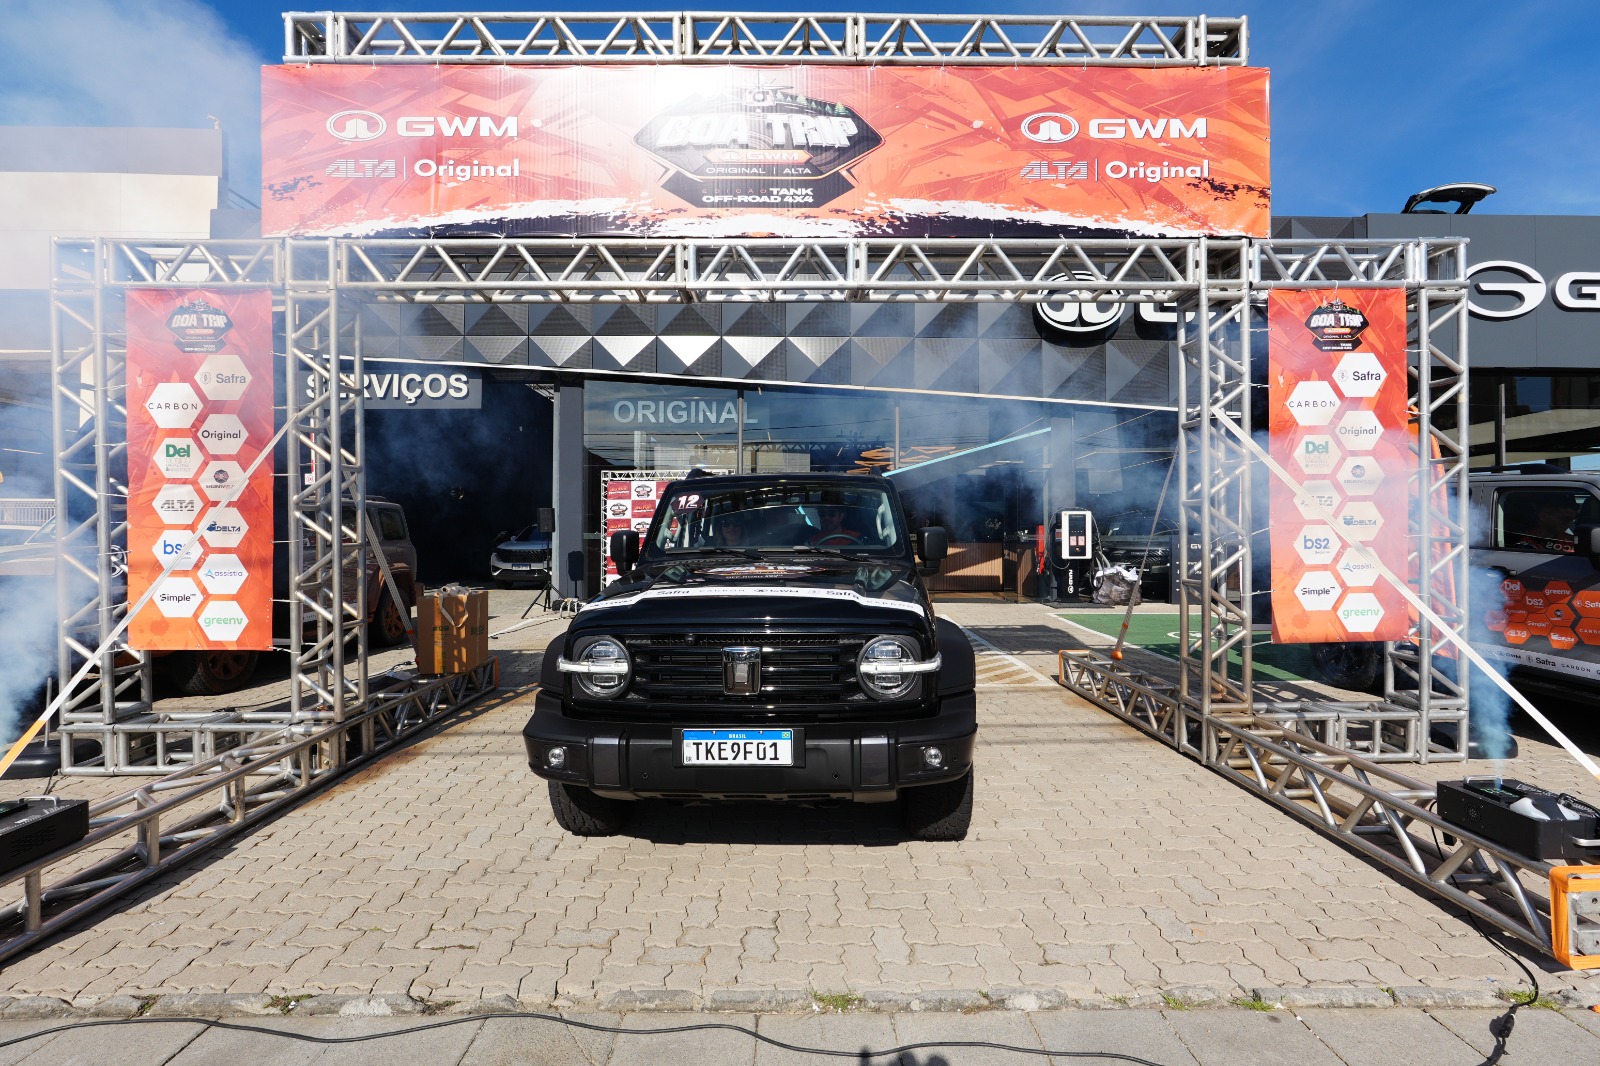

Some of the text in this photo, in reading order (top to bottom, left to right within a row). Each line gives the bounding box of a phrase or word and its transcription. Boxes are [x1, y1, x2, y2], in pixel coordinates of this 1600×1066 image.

[397, 116, 518, 137] GWM
[766, 112, 859, 149] TRIP
[1088, 118, 1207, 139] GWM
[746, 151, 799, 161] GWM
[325, 158, 520, 181] ALTA Original
[705, 166, 812, 175] ORIGINAL ALTA
[1020, 160, 1209, 183] ALTA Original
[769, 187, 814, 196] TANK
[701, 195, 781, 203] OFF-ROAD
[171, 313, 228, 328] BOA TRIP
[1310, 313, 1363, 328] BOA TRIP
[216, 373, 246, 384] Safra
[1352, 371, 1381, 381] Safra
[148, 402, 198, 410] CARBON
[613, 400, 759, 424] ORIGINAL
[201, 429, 241, 441] Original
[1339, 426, 1377, 437] Original
[165, 444, 191, 458] Del
[1305, 441, 1329, 455] Del
[160, 499, 195, 512] ALTA
[678, 494, 700, 510] 12
[1303, 535, 1331, 550] bs2
[160, 593, 191, 603] Simple
[1301, 587, 1331, 597] Simple
[1343, 608, 1380, 619] greenv
[204, 617, 243, 627] greenv
[692, 742, 780, 761] TKE9F01
